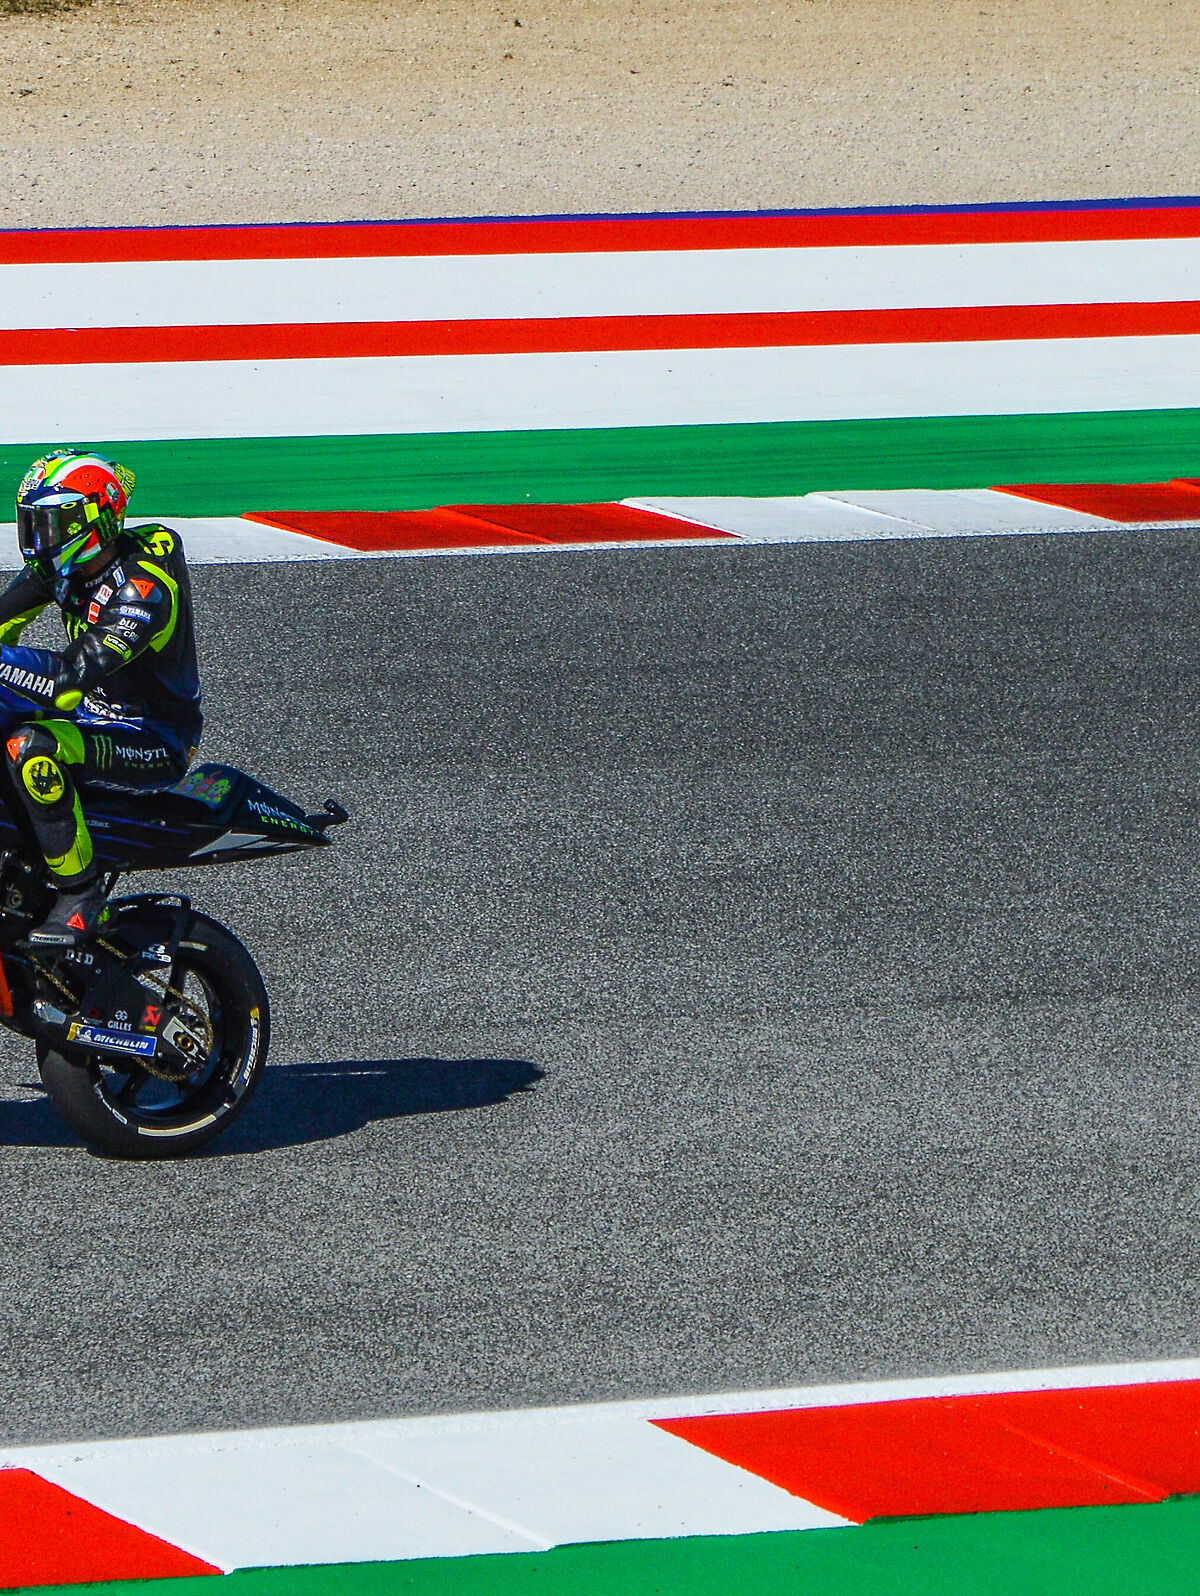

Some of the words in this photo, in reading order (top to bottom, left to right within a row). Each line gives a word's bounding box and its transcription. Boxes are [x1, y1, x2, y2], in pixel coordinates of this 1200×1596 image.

[261, 815, 315, 836] ENERGY
[107, 1020, 132, 1032] GILLES
[93, 1033, 150, 1050] MICHELIN
